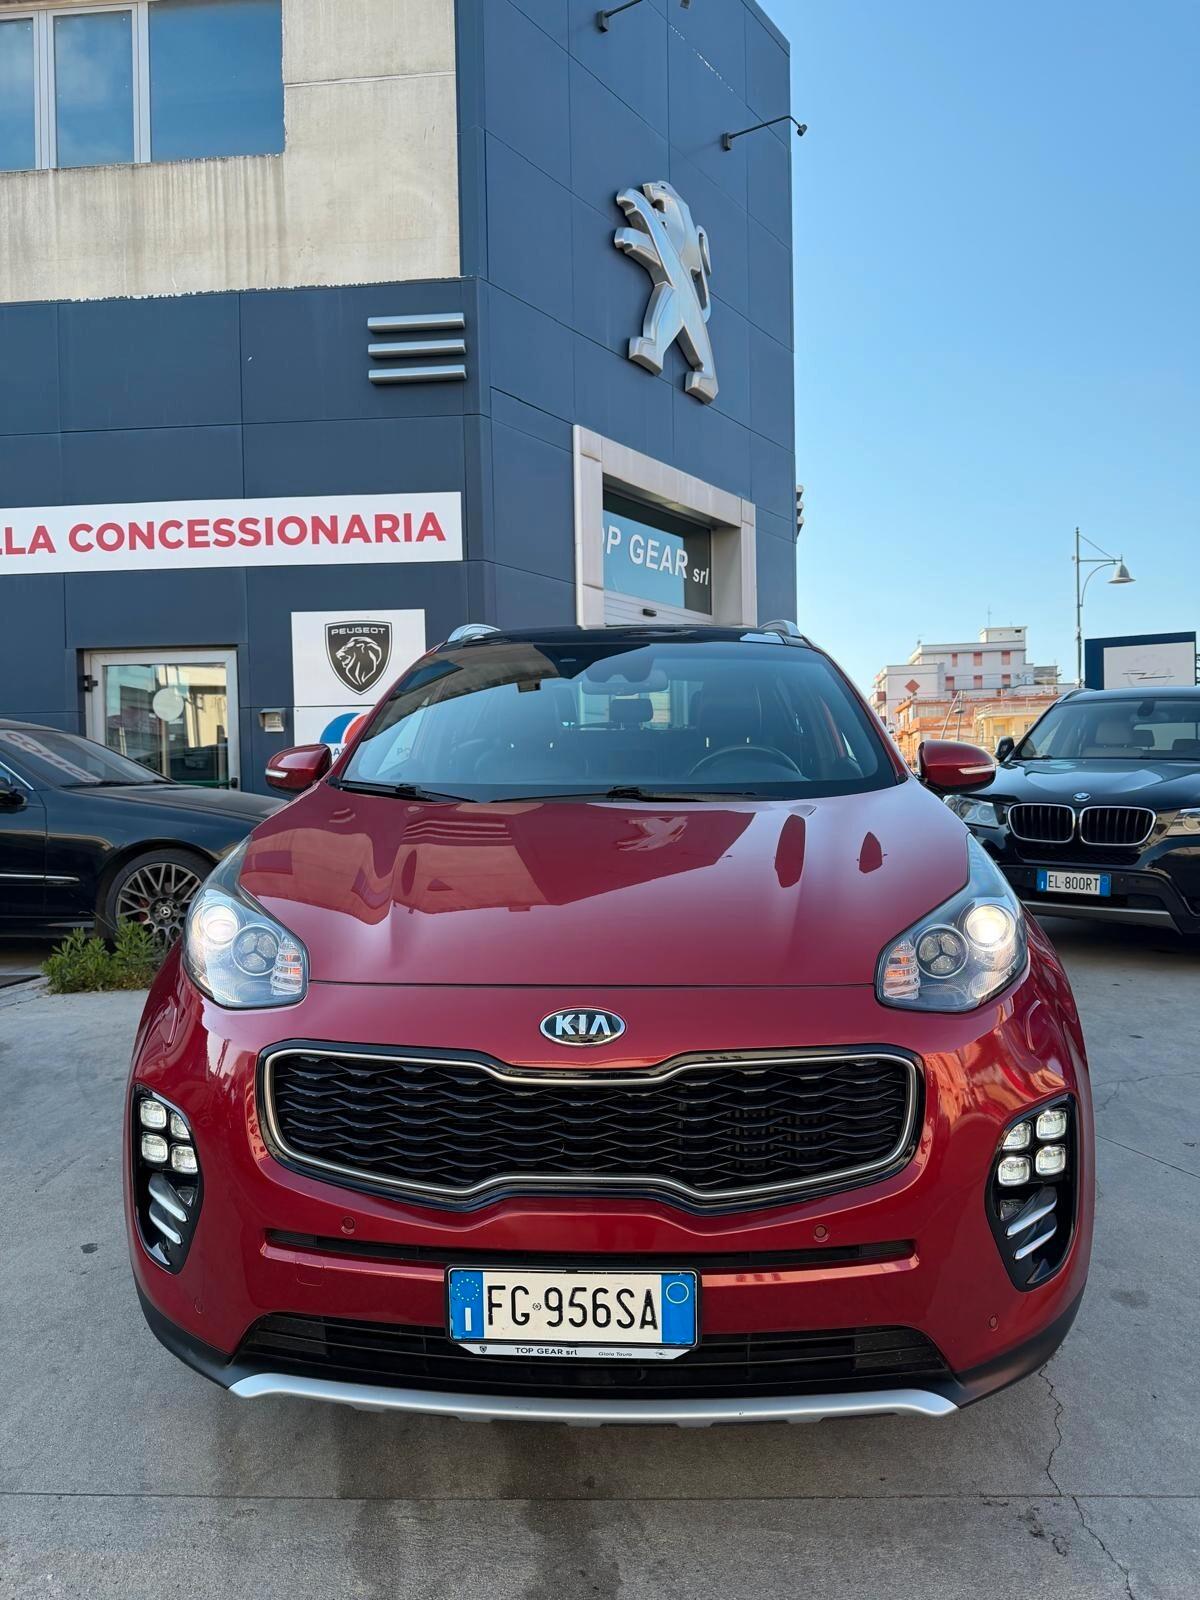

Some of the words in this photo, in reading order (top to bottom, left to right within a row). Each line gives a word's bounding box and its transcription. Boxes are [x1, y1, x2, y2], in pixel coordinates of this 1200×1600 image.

[0, 525, 56, 555] LA
[68, 512, 447, 553] CONCESSIONARIA
[629, 534, 689, 579] GEAR
[692, 567, 710, 585] srl
[331, 627, 386, 636] PEUGEOT
[555, 1014, 611, 1036] KIA
[464, 1307, 472, 1331] I
[487, 1285, 530, 1326] FG
[544, 1287, 658, 1330] 956SA
[537, 1347, 563, 1355] GEAR
